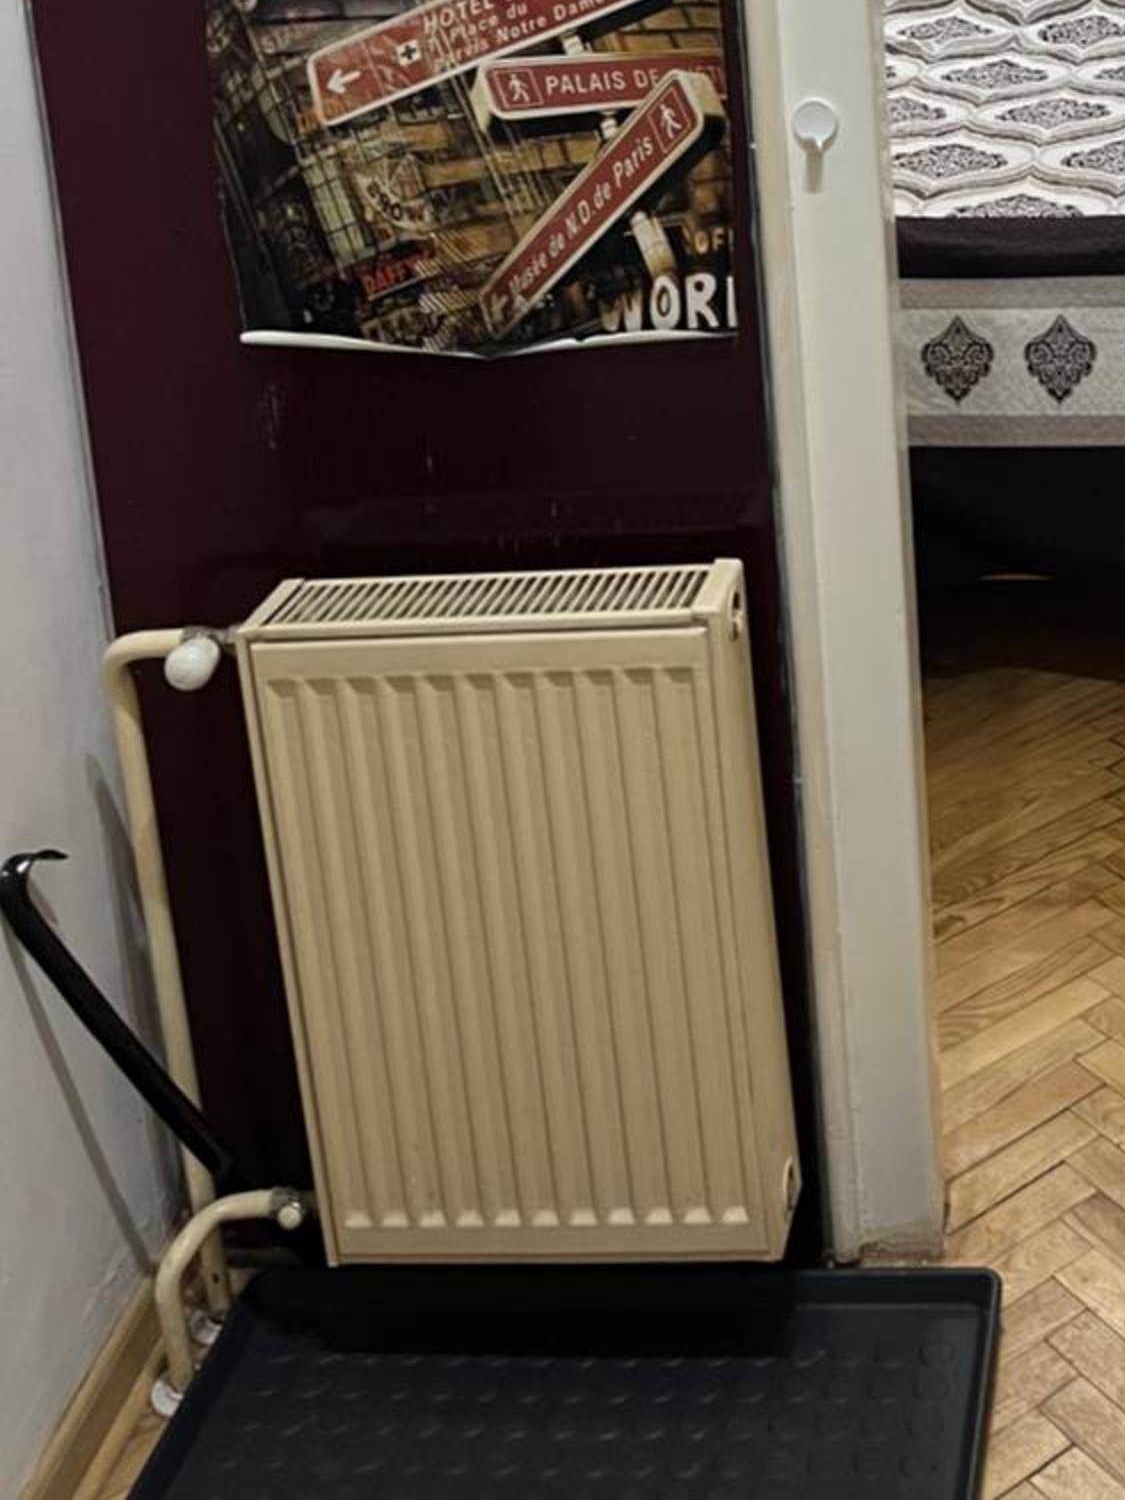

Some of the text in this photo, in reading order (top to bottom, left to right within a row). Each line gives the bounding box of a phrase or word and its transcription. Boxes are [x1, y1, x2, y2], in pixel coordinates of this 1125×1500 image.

[506, 3, 528, 20] du
[495, 15, 548, 44] Notre
[544, 71, 625, 97] PALAIS
[611, 136, 654, 188] Paris
